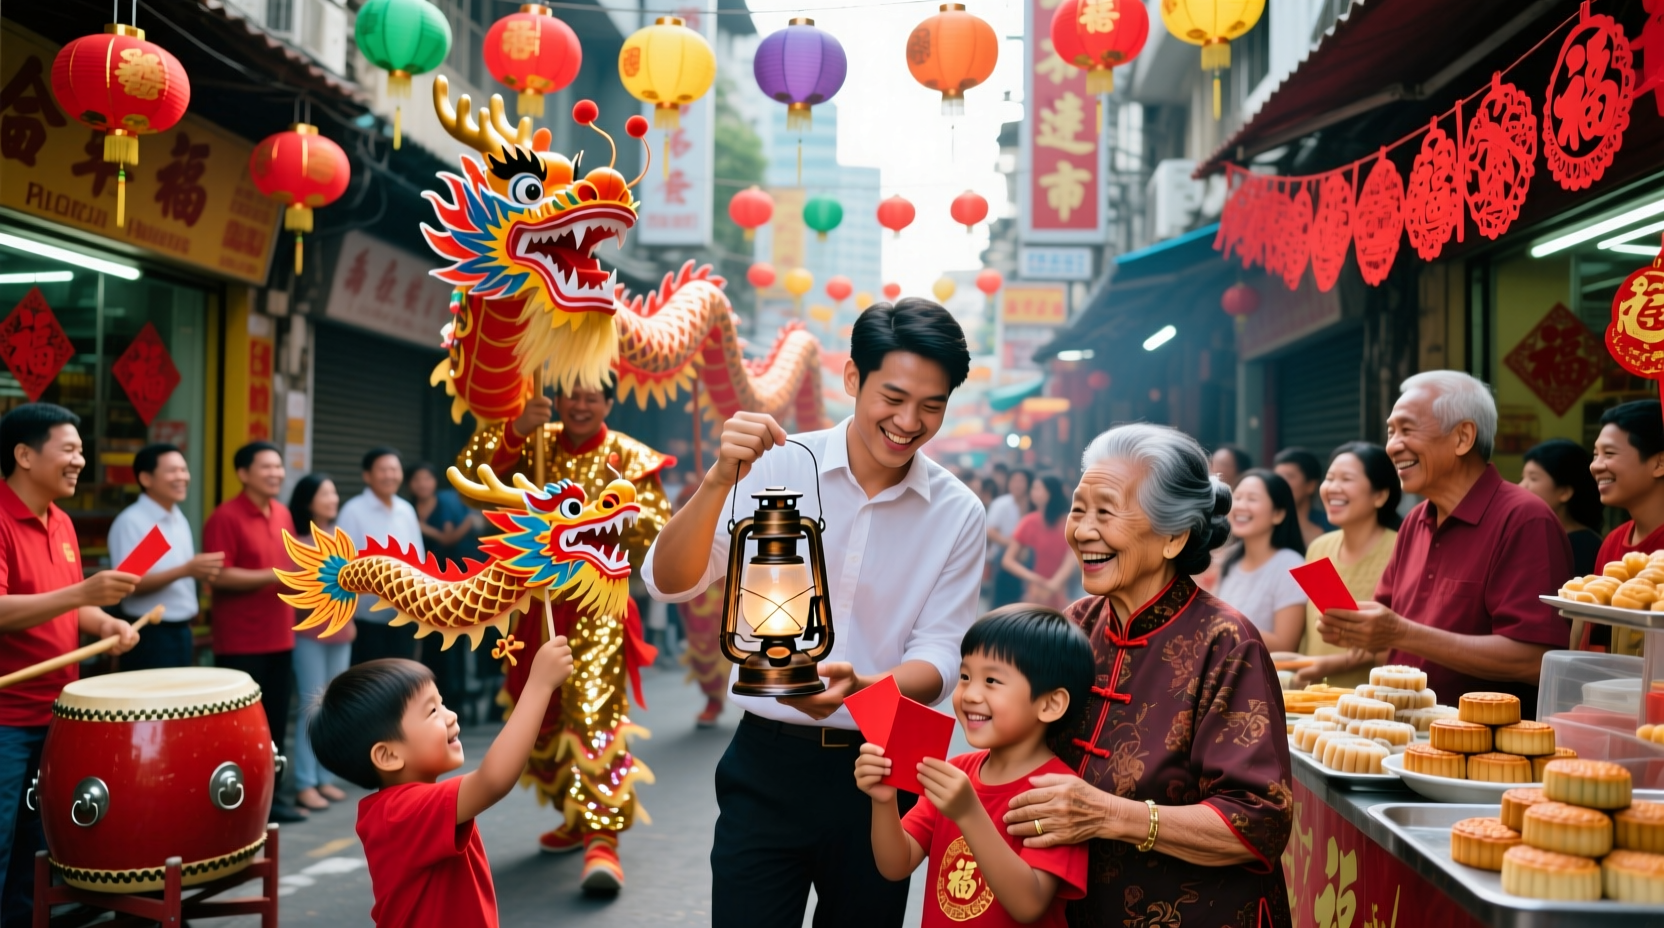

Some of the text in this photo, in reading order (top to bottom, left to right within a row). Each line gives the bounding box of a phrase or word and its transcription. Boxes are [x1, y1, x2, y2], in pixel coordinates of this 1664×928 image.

[1553, 27, 1618, 152] 福
[9, 308, 55, 376] 福
[127, 341, 166, 401] 福
[1528, 323, 1590, 387] 福
[947, 858, 977, 900] 福
